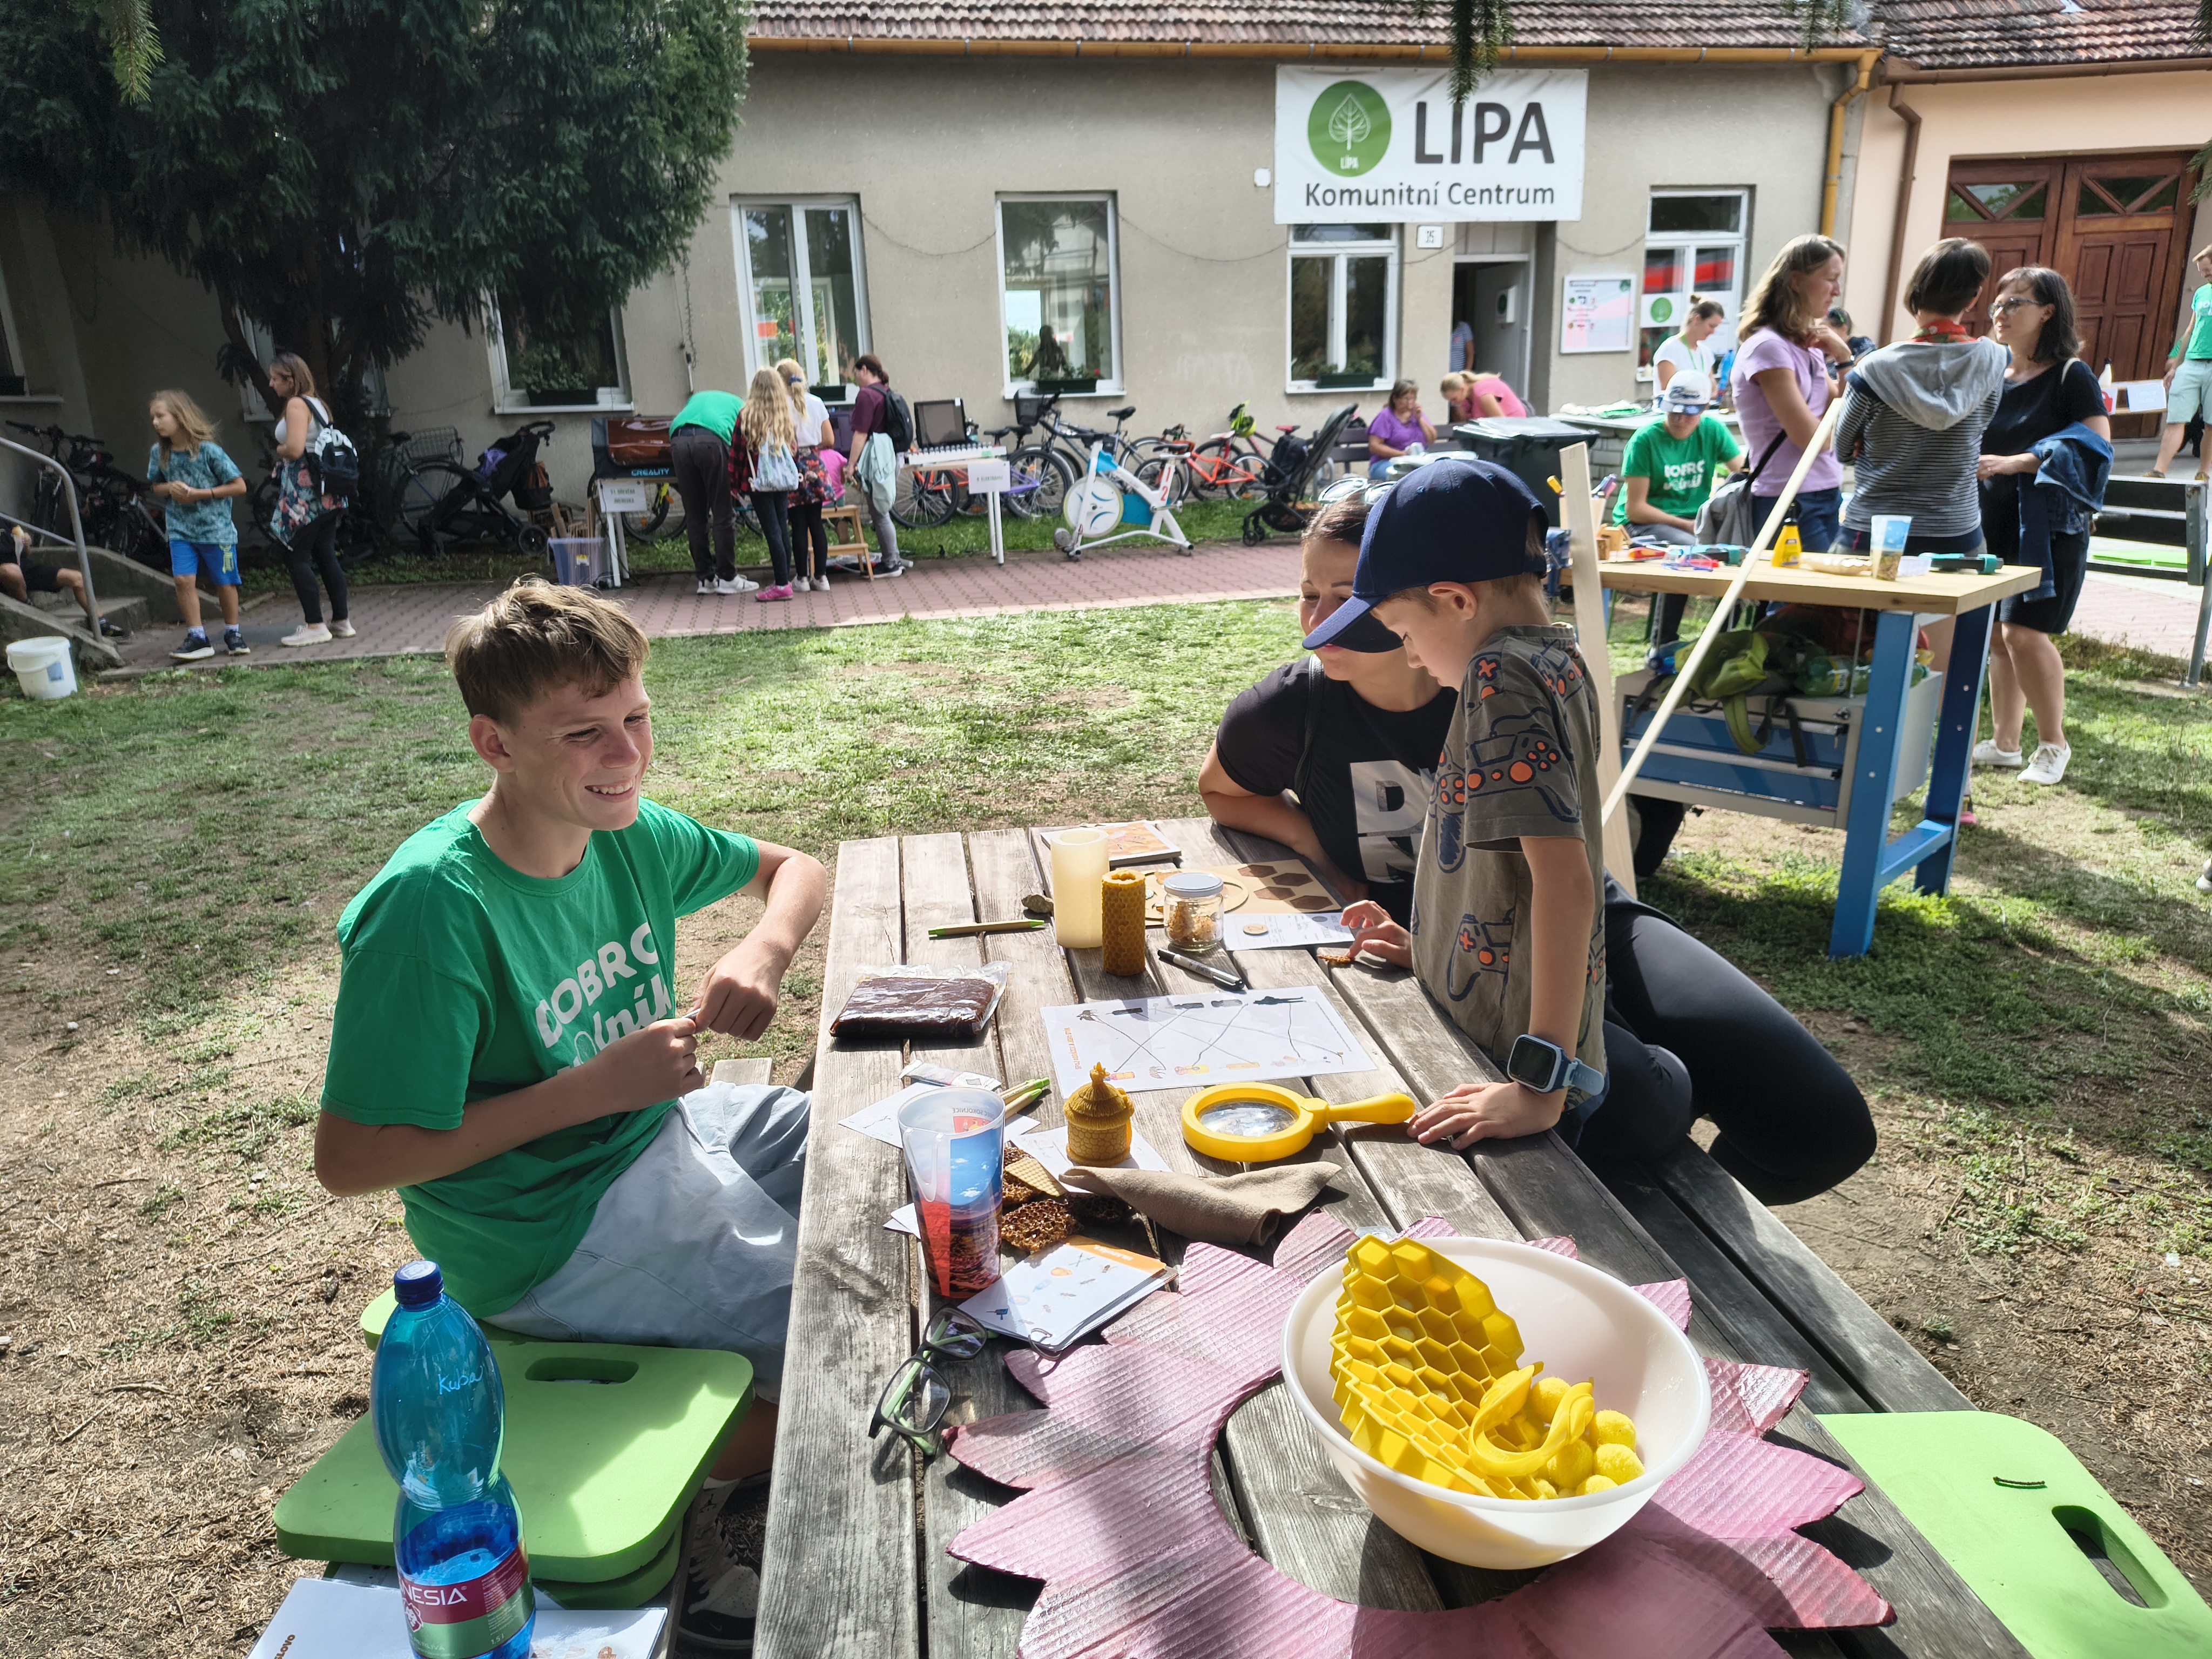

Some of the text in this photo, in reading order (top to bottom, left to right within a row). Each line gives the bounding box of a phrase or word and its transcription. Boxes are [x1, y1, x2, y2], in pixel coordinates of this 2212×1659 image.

[1306, 181, 1554, 206] Komunitní Centrum
[631, 468, 669, 476] CREALITY
[438, 1365, 483, 1395] Kuba
[400, 1578, 467, 1606] NESIA
